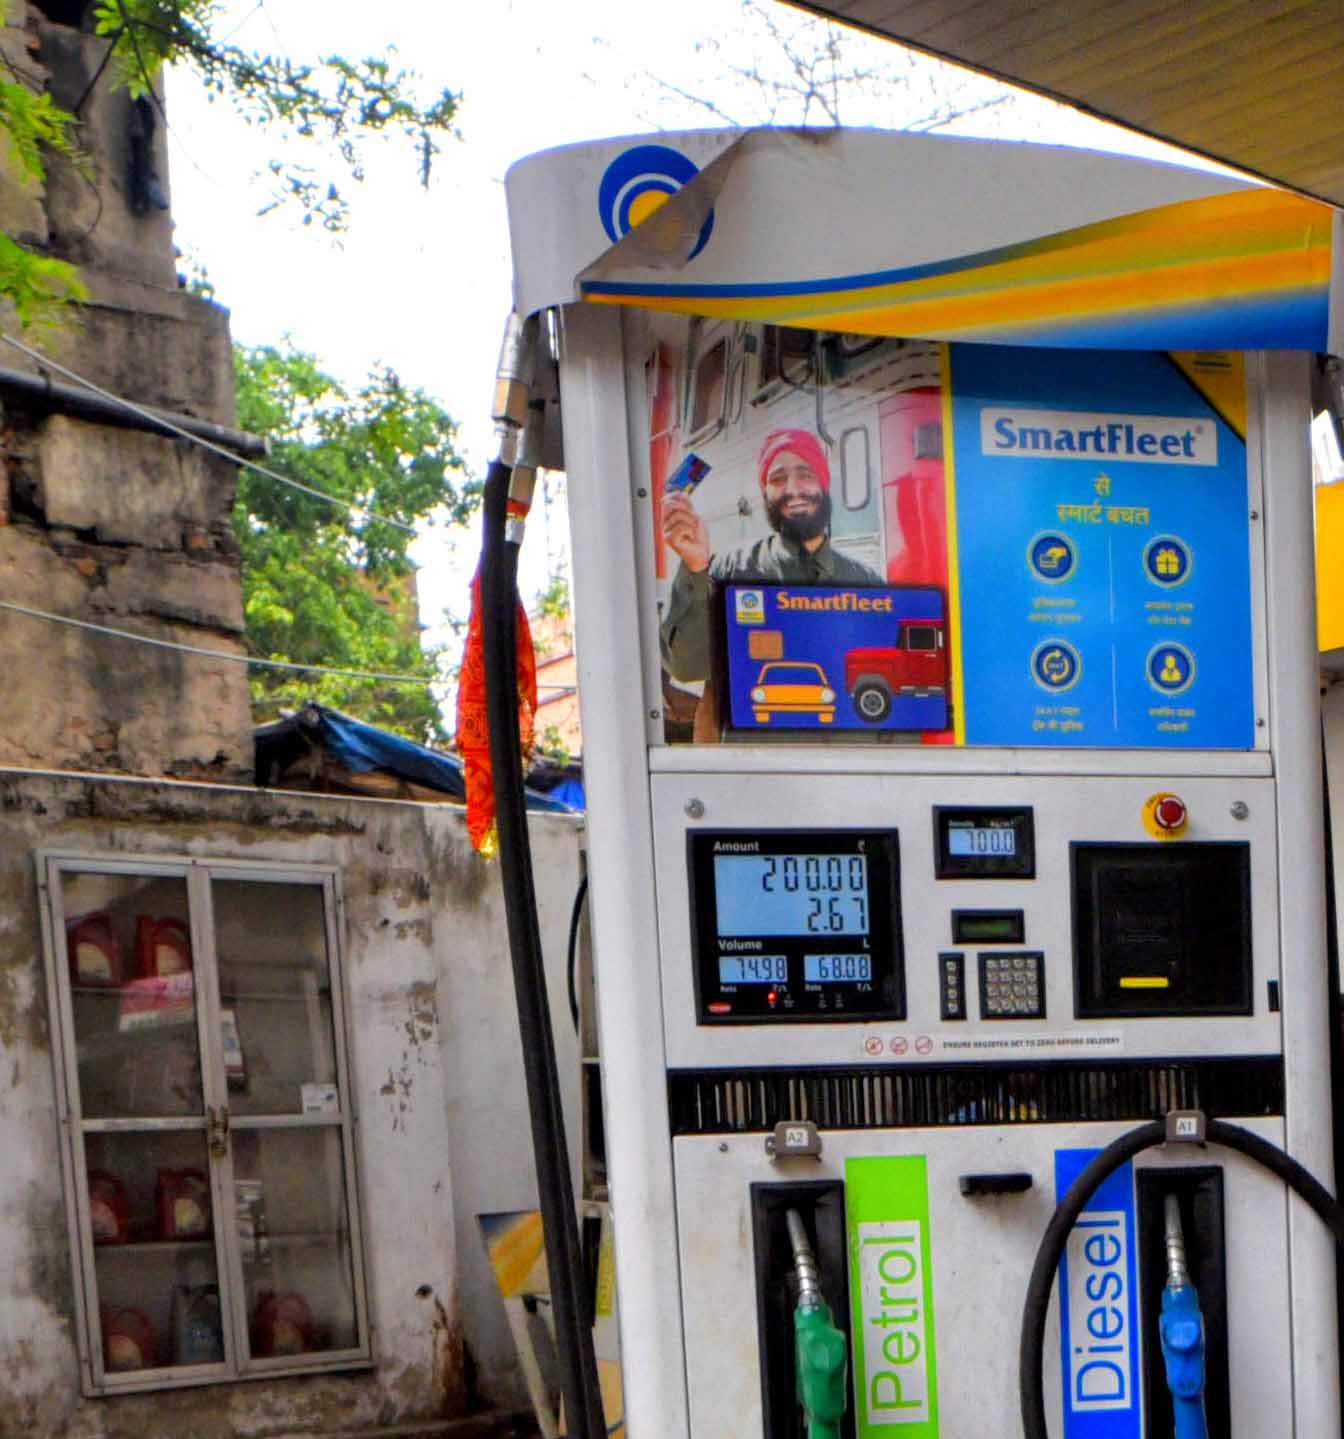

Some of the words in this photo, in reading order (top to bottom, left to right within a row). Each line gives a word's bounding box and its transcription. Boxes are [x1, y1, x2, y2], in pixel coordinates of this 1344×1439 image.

[994, 417, 1195, 457] SmartFleet
[776, 591, 892, 612] SmartFleet
[713, 841, 760, 852] Amount
[762, 856, 864, 892] 200.00
[807, 897, 866, 932] 2.67
[718, 939, 763, 951] Volume
[736, 957, 786, 981] 74.98
[818, 956, 869, 980] 68.08
[788, 1131, 804, 1143] A2
[1178, 1120, 1192, 1132] A1
[864, 1233, 922, 1411] Petrol
[1074, 1218, 1125, 1403] Diesel
